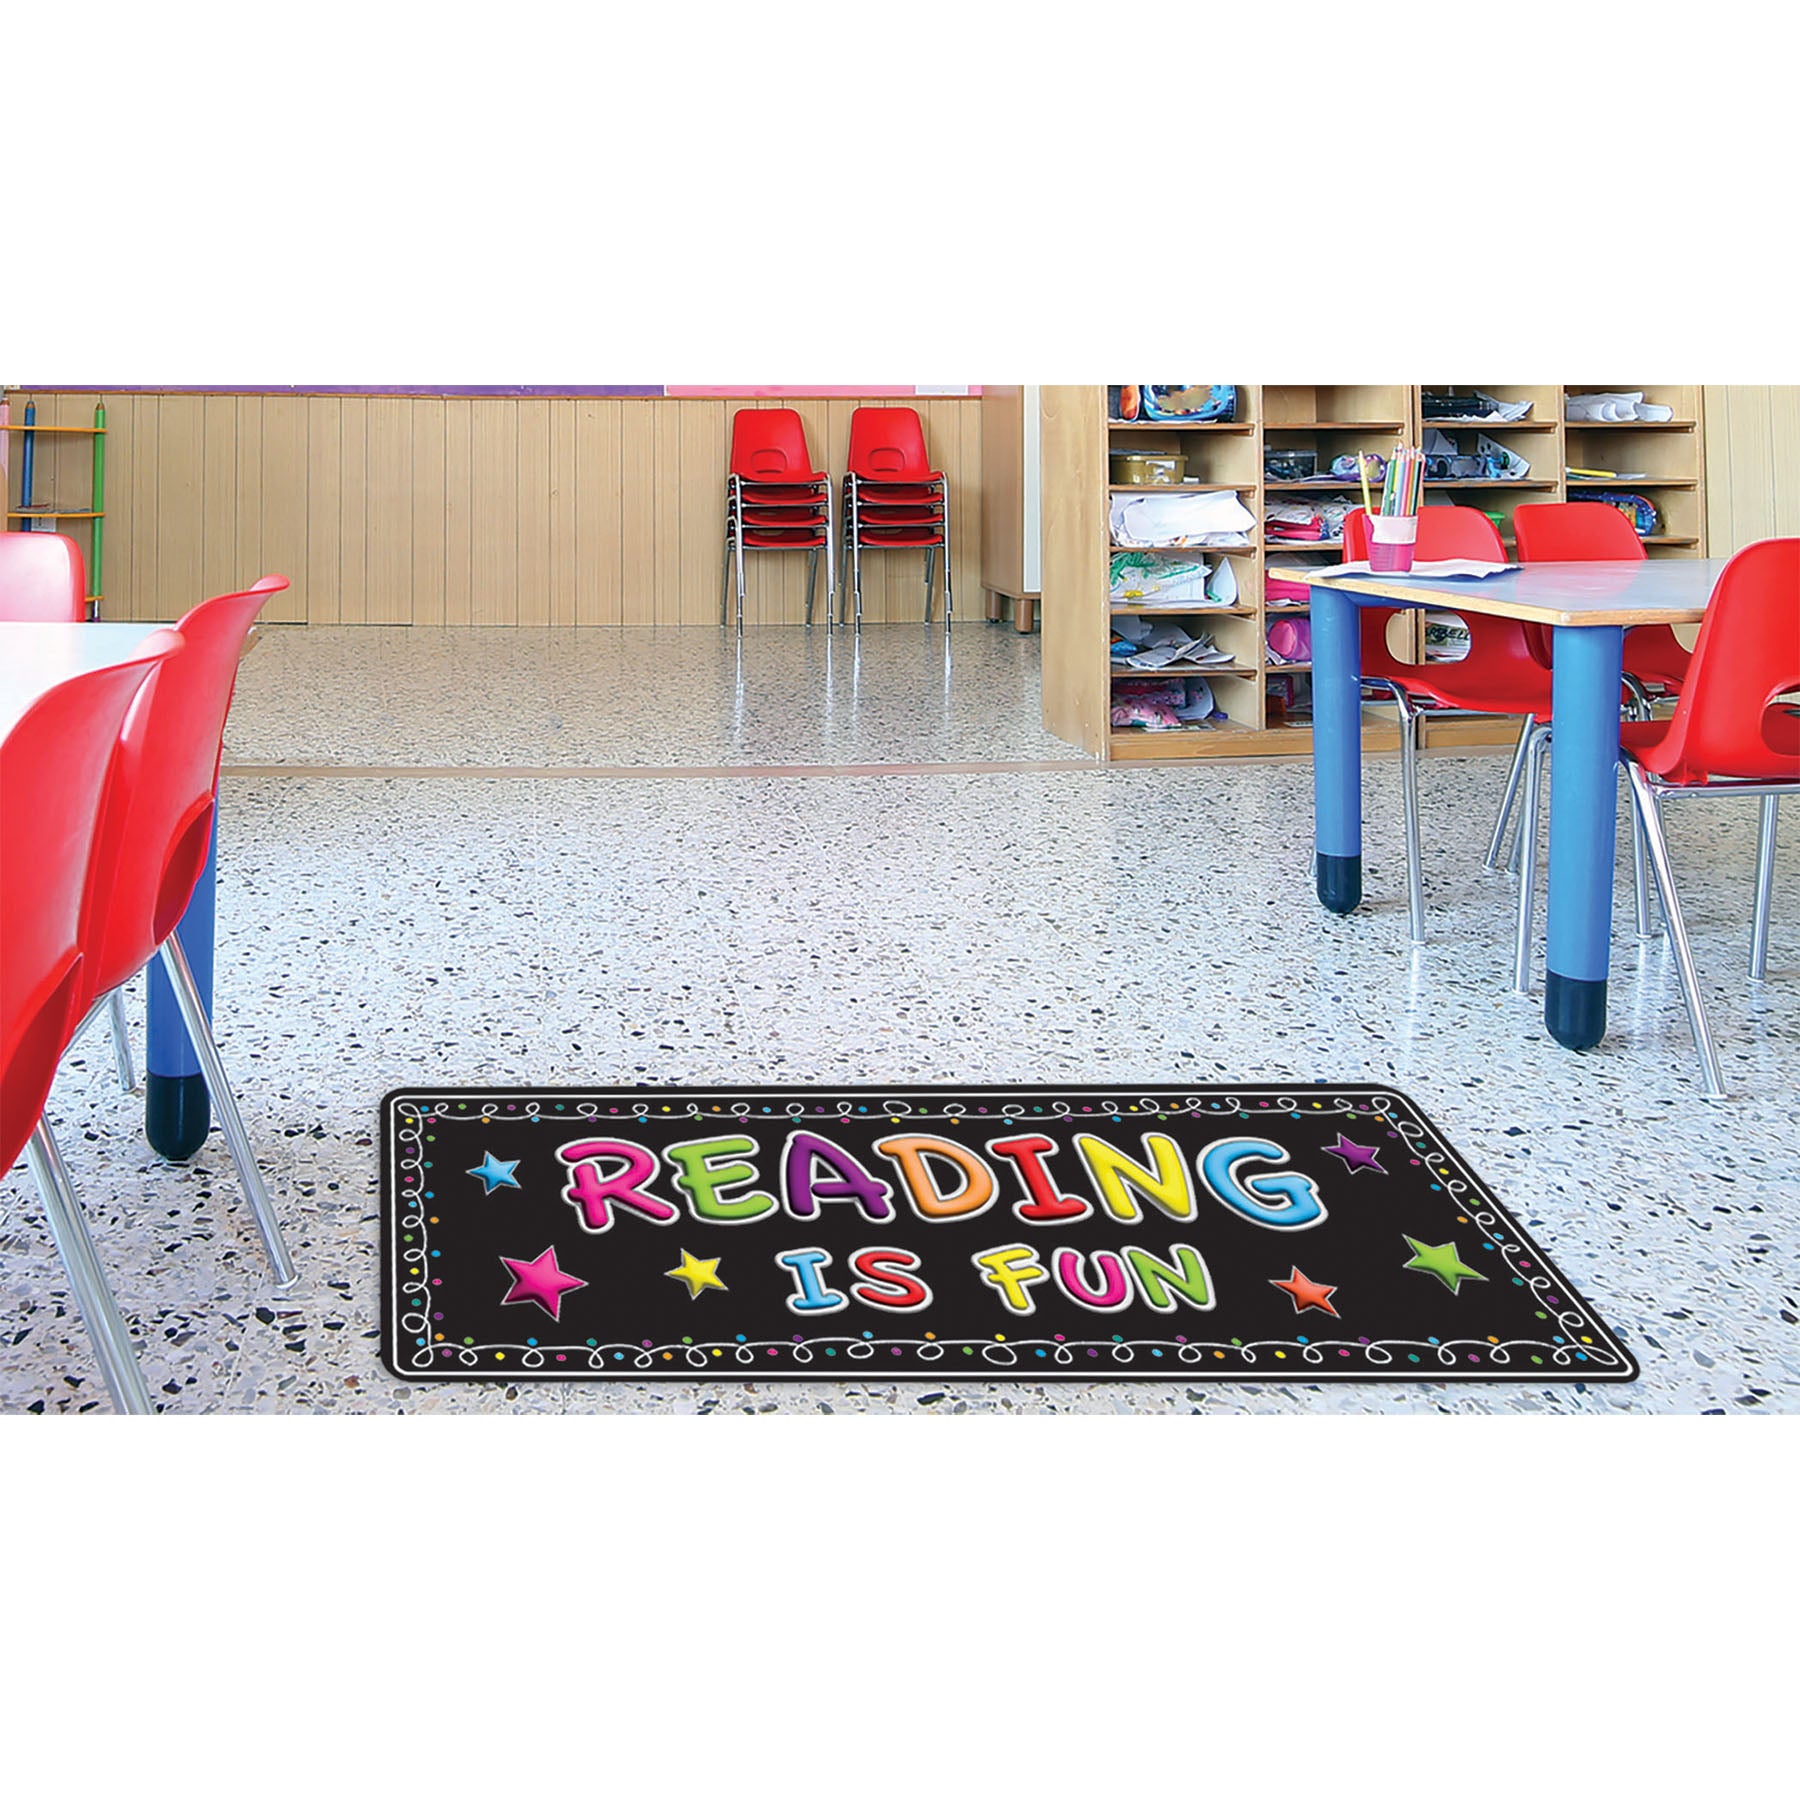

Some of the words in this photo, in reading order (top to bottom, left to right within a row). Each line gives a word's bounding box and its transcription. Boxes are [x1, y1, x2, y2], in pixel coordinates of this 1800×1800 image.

[556, 1131, 1328, 1234] READING
[776, 1246, 933, 1316] IS
[972, 1243, 1216, 1316] FUN
